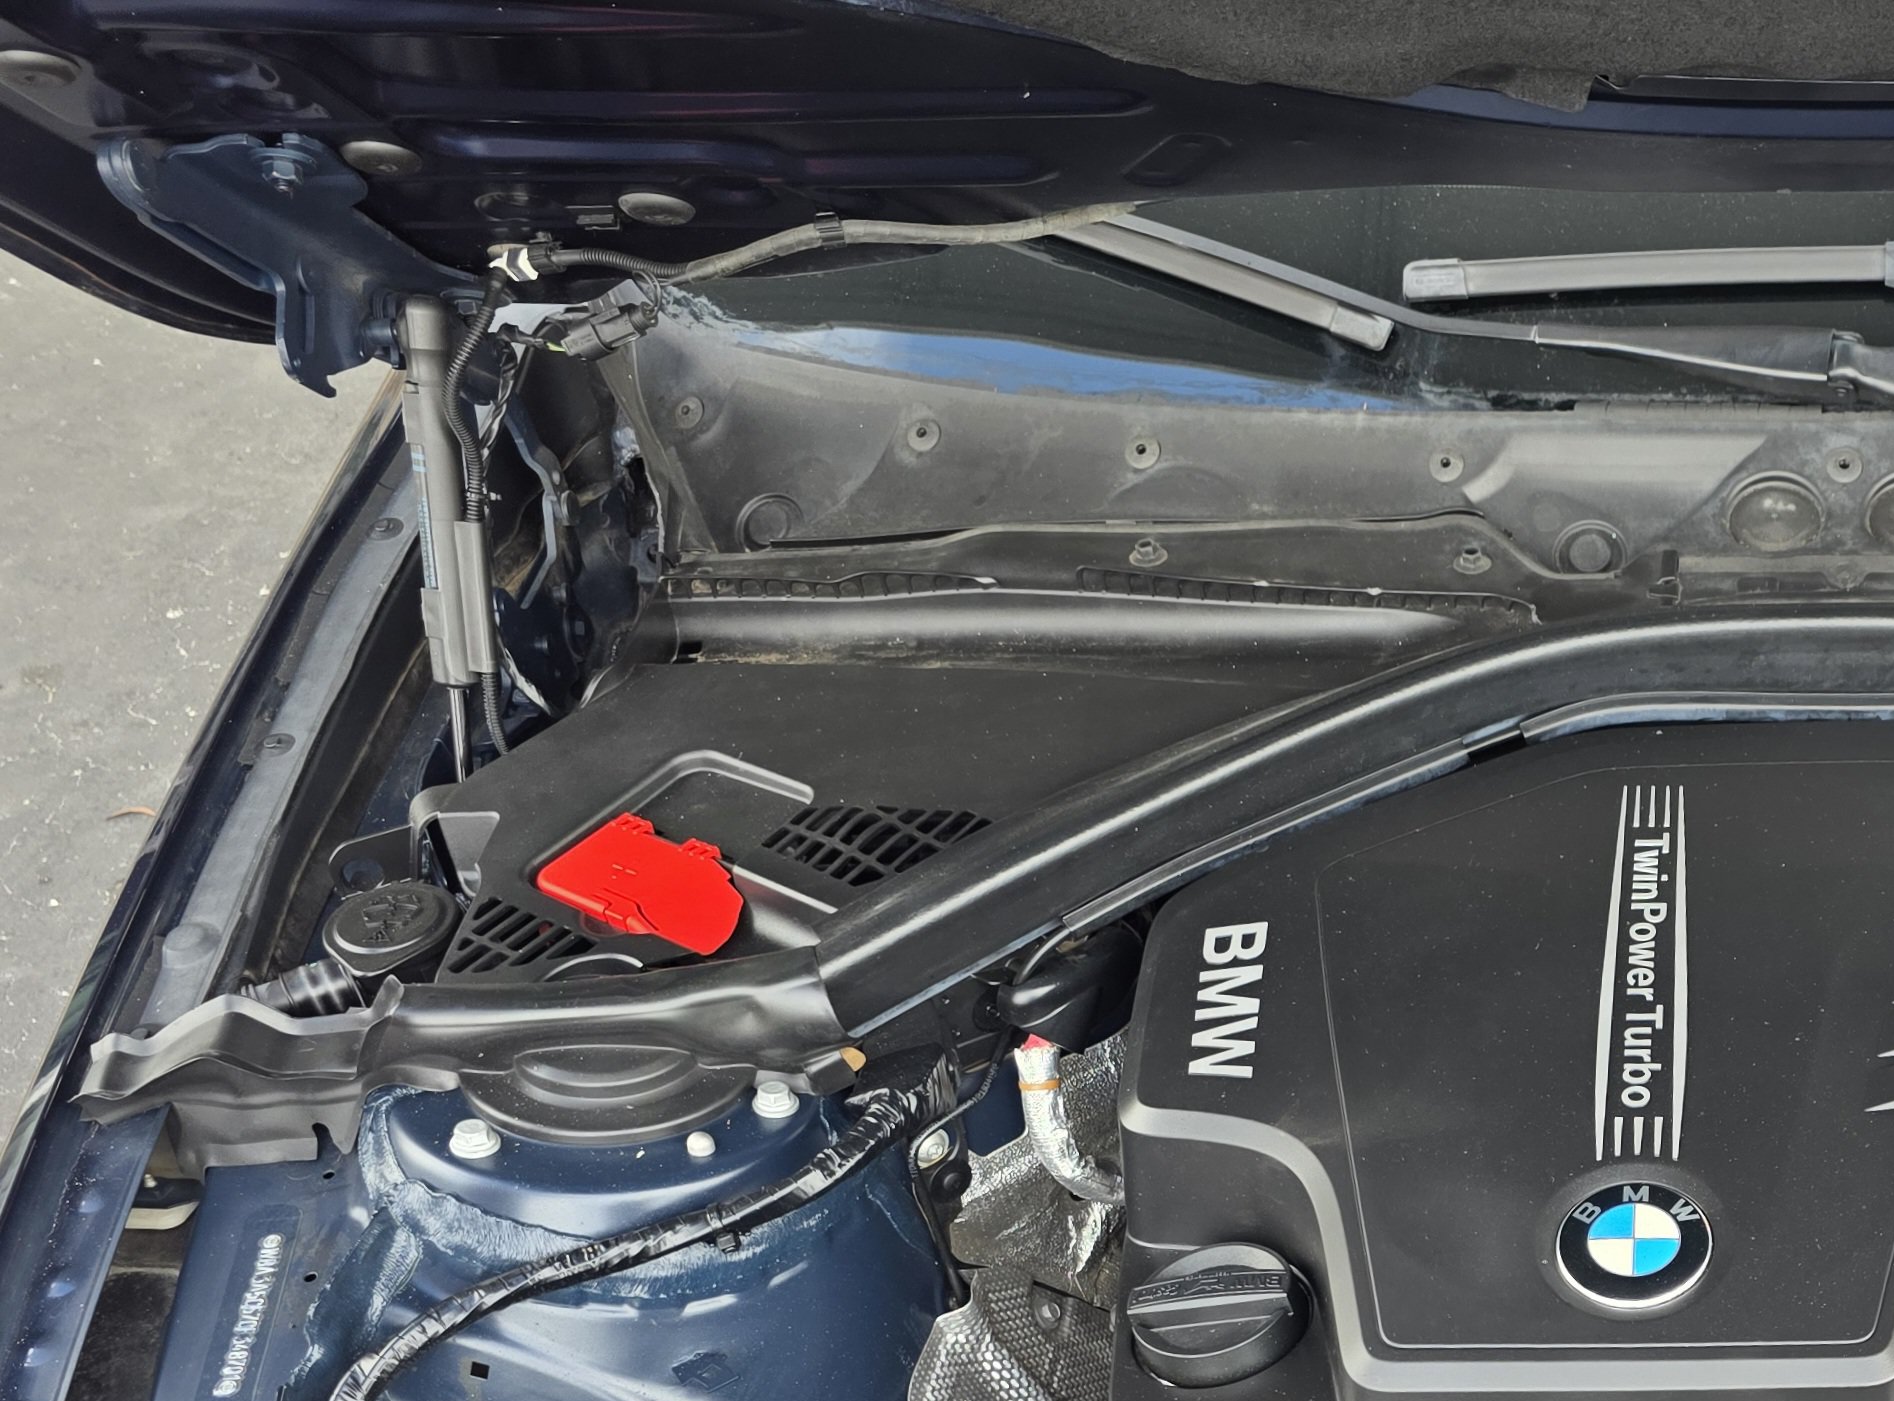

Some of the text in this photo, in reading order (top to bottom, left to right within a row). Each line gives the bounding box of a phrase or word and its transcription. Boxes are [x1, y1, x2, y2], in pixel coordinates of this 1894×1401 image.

[1188, 921, 1268, 1078] BMW
[1620, 832, 1670, 1109] TwinPower Turbo
[1572, 1185, 1700, 1224] BMW
